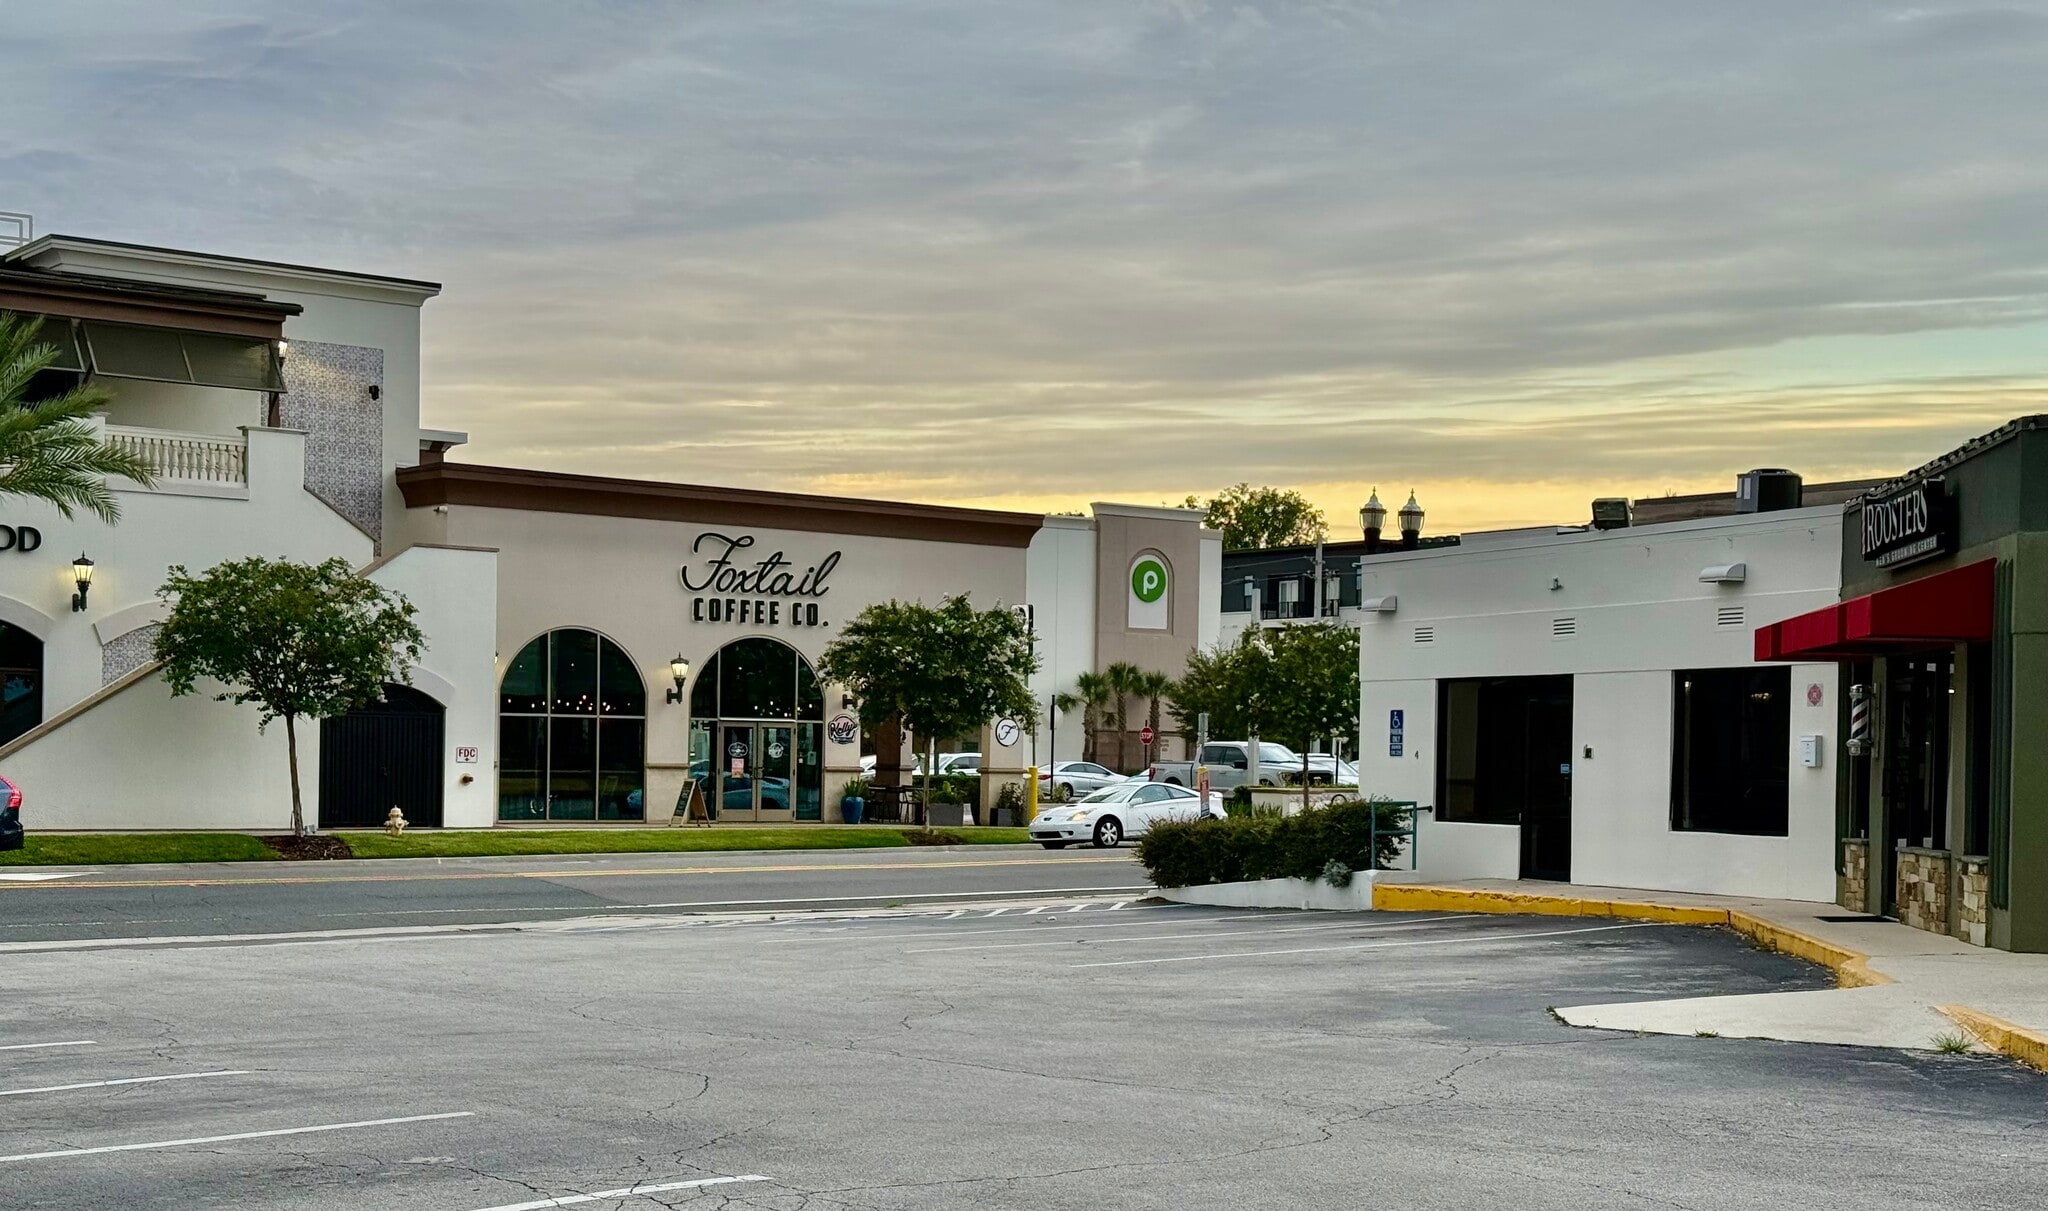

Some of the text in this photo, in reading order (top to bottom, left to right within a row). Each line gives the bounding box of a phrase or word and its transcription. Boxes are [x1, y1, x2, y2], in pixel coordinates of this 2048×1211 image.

[1866, 479, 1928, 553] ROOSTERS
[681, 532, 842, 597] Foxtail
[693, 597, 829, 627] COFFEE CO.
[458, 748, 476, 758] FDC
